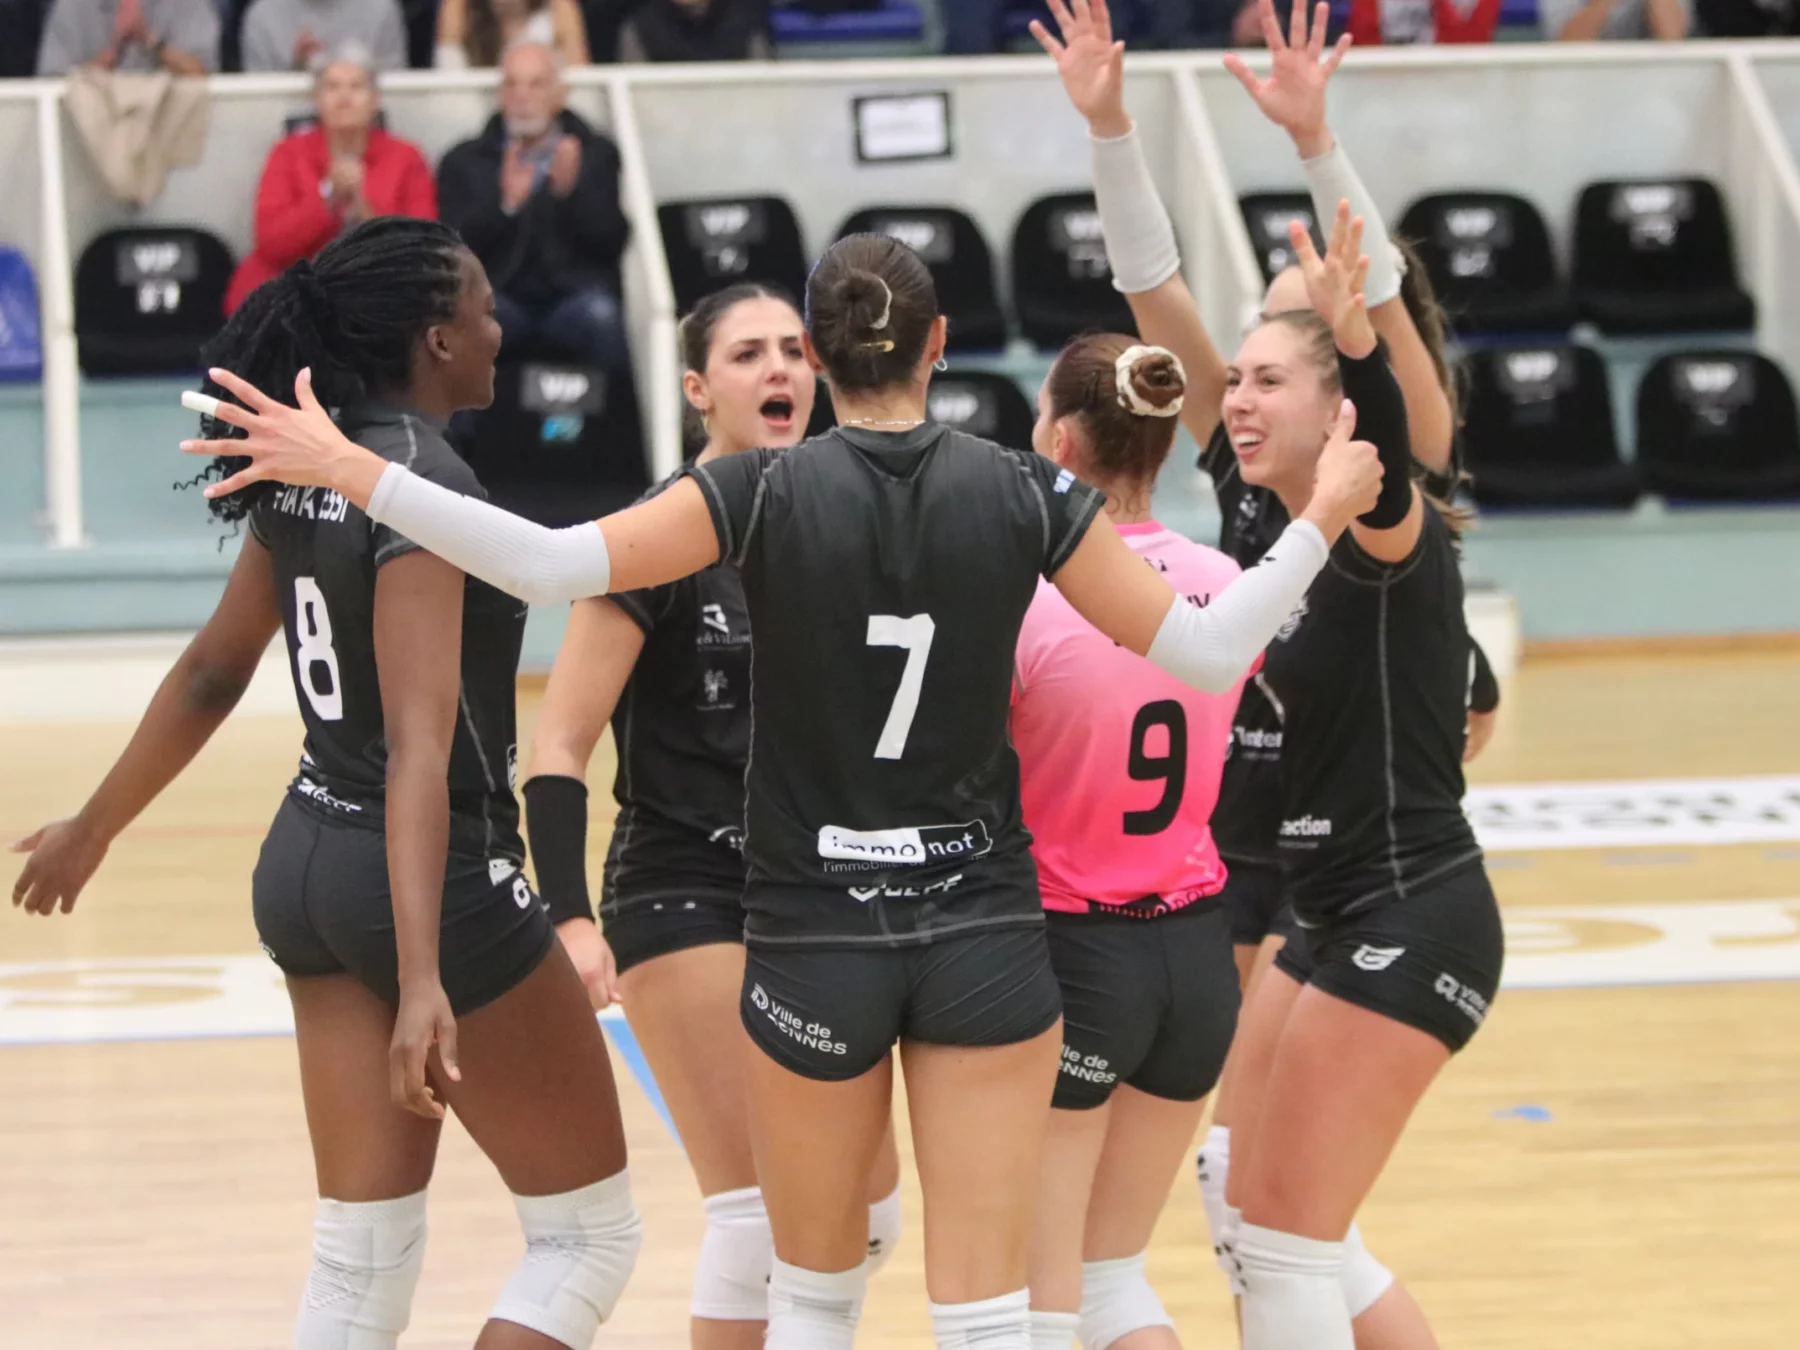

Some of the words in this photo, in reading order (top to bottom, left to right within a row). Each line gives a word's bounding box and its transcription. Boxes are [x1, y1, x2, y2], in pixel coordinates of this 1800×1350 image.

[132, 242, 181, 273] VIP
[540, 371, 590, 403] VIP
[294, 576, 343, 721] 8
[866, 613, 936, 760] 7
[1123, 698, 1188, 835] 9
[927, 831, 974, 856] not
[771, 1001, 803, 1030] Ville
[805, 1023, 832, 1039] de
[1083, 1054, 1109, 1071] de
